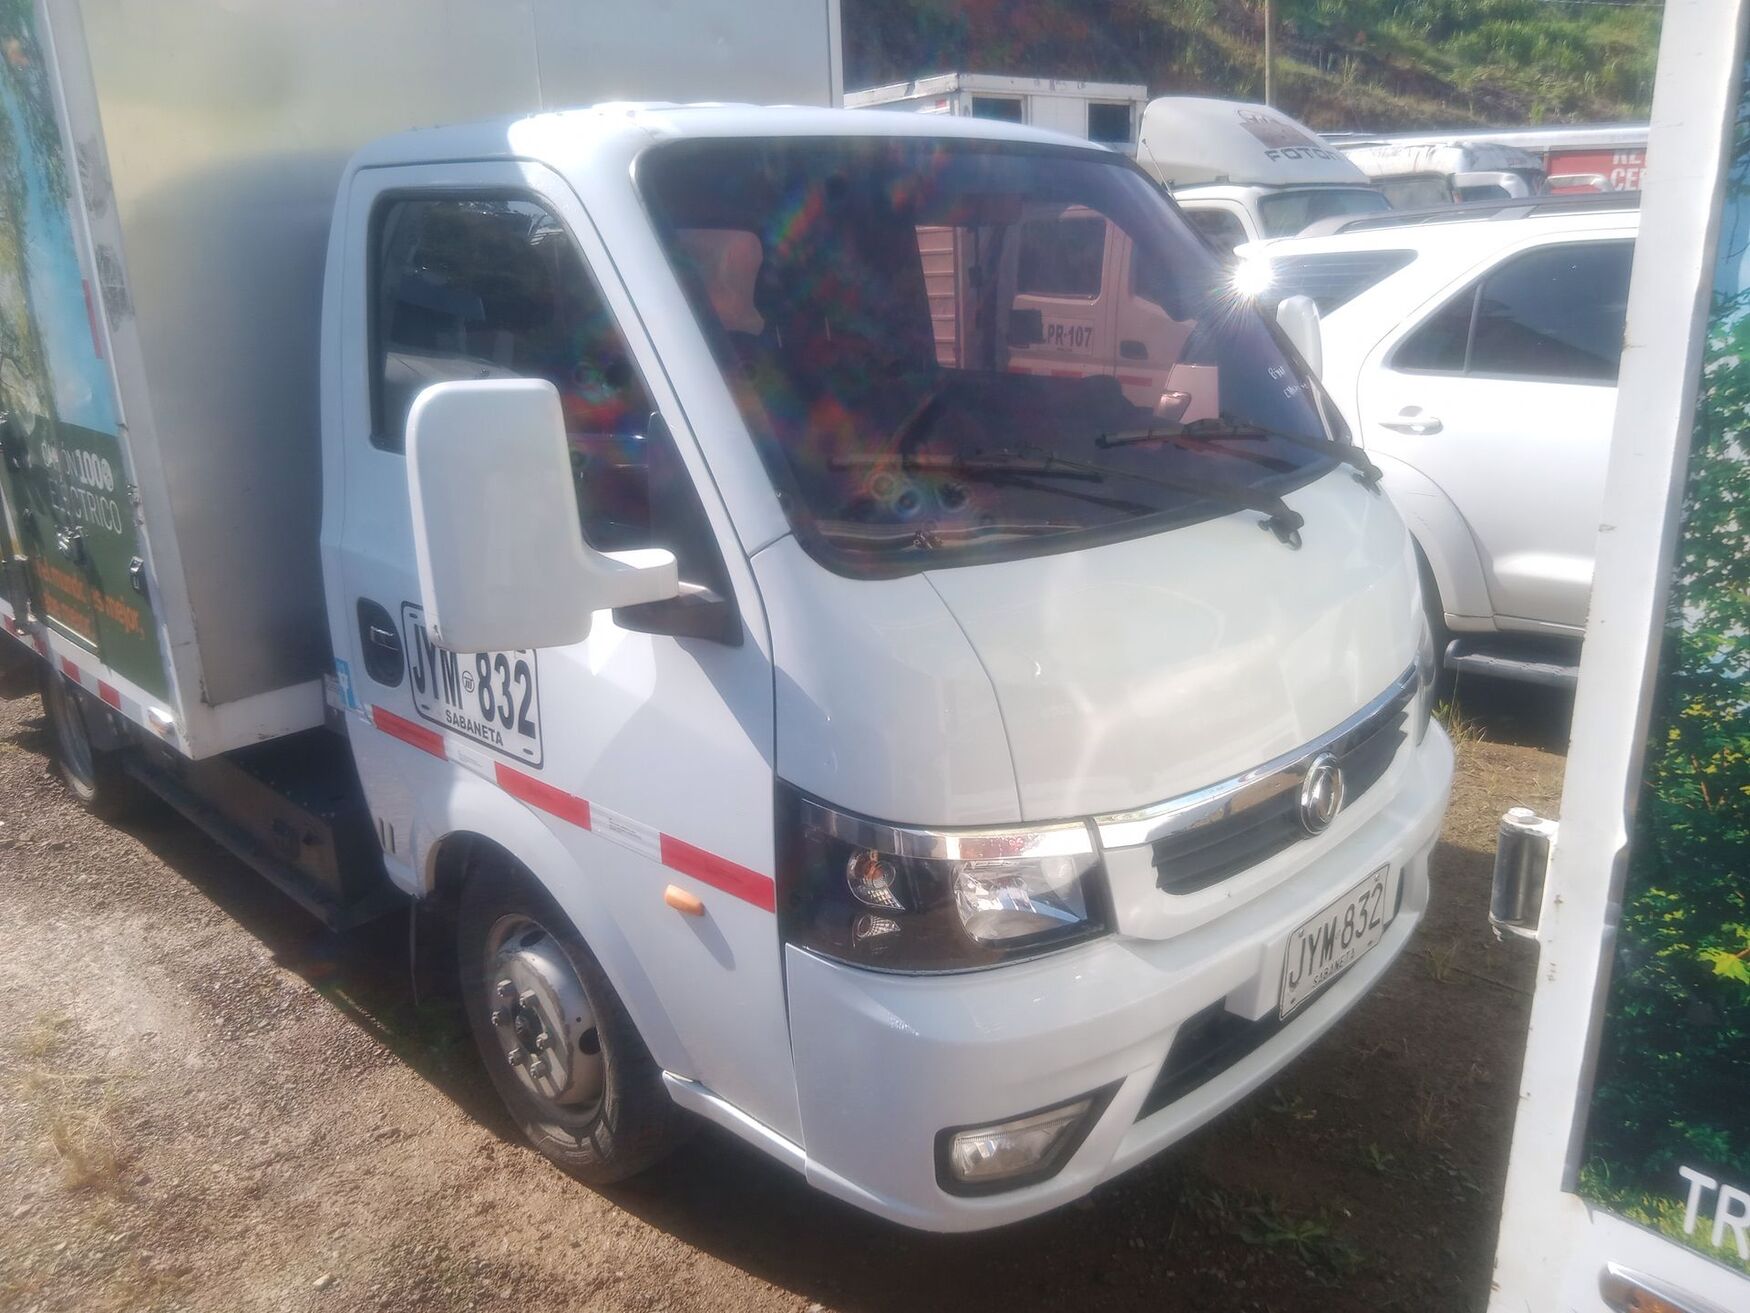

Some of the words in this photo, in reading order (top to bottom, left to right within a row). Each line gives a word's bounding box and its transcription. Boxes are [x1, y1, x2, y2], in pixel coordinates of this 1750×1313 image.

[445, 709, 504, 747] SABANETA
[475, 652, 536, 740] 832
[1341, 882, 1384, 949] 832
